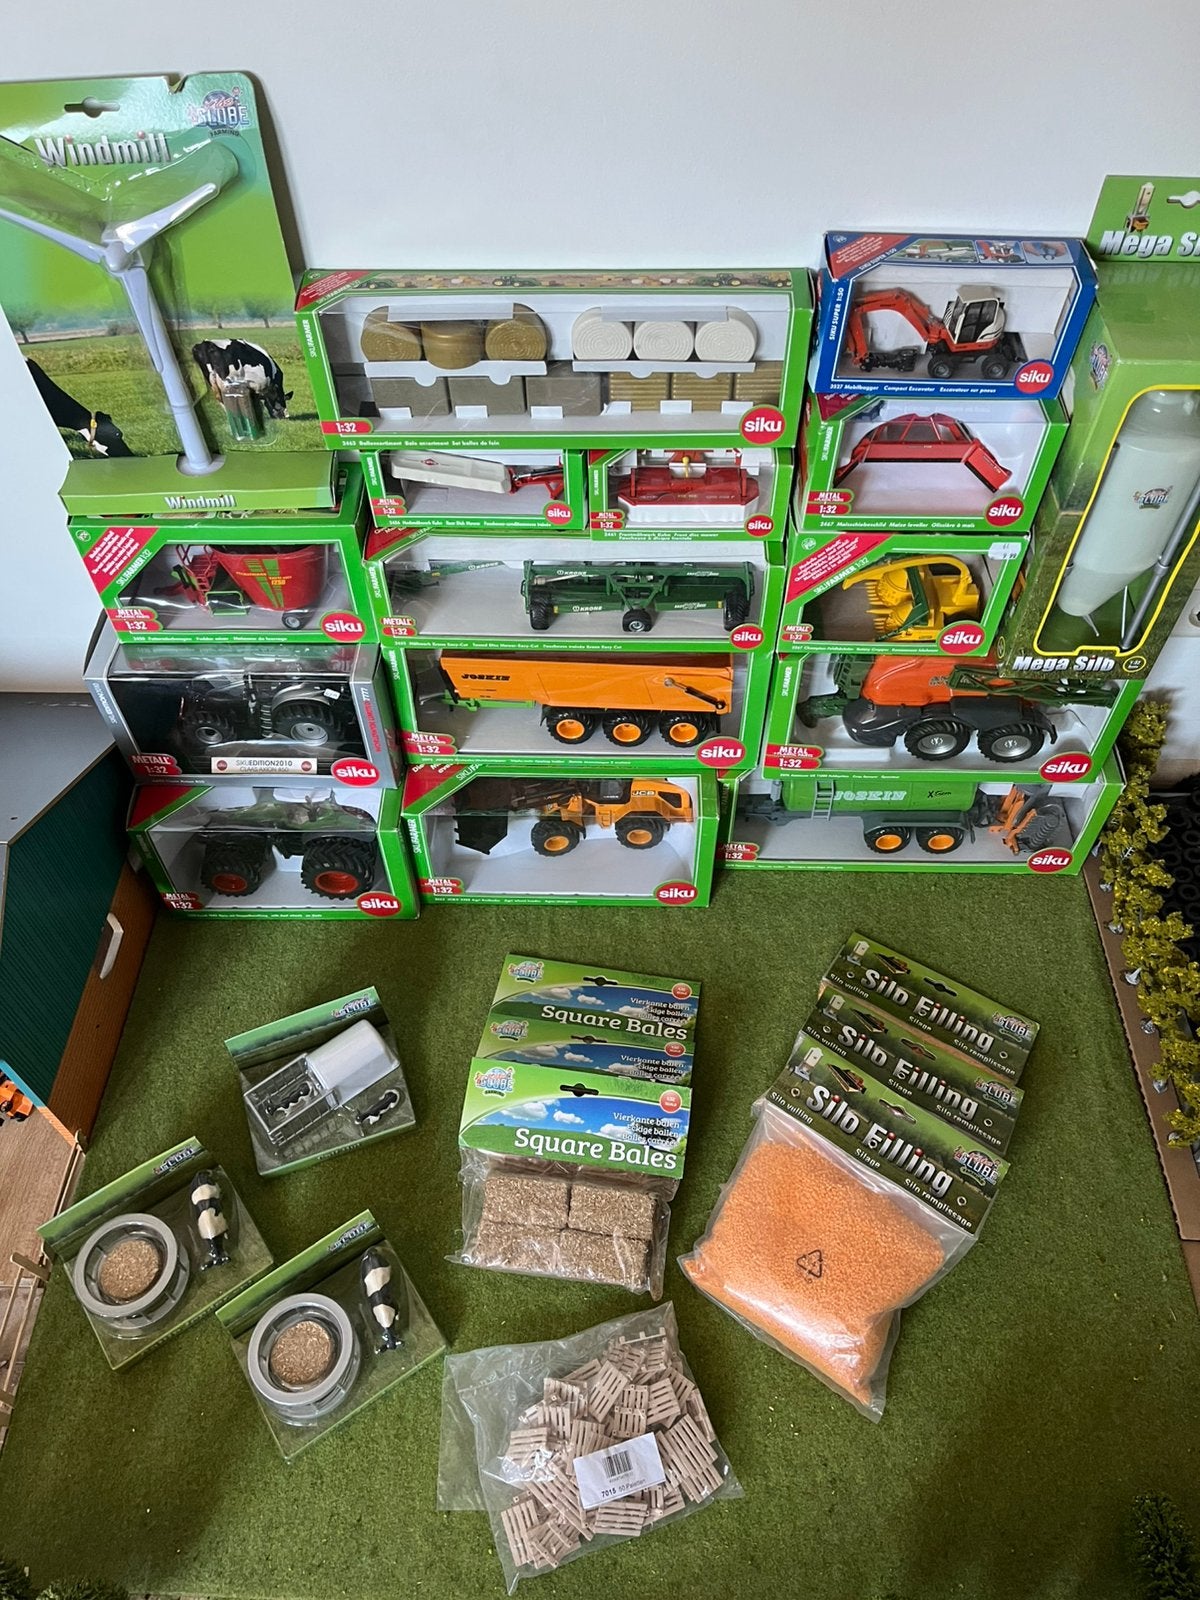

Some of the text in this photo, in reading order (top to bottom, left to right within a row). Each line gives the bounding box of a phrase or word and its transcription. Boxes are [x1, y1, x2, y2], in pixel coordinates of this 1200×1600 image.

[35, 130, 171, 167] Windmill
[1101, 231, 1173, 258] Mega
[829, 287, 845, 340] SIKU SUPER 1:50
[1018, 370, 1051, 384] siku
[335, 422, 357, 433] 1:32
[744, 417, 782, 433] siku
[164, 494, 237, 509] Windmill
[818, 492, 841, 500] METAL
[547, 508, 570, 518] siku
[819, 505, 838, 514] 1:32
[988, 506, 1022, 518] siku
[600, 521, 614, 529] 1:32
[747, 521, 772, 530] siku
[813, 565, 857, 595] SIKUFARMER
[854, 557, 869, 568] 1:32
[125, 621, 148, 630] 1:32
[325, 619, 363, 633] siku
[382, 617, 413, 626] METALL
[390, 628, 408, 636] 1:32
[733, 632, 762, 642] siku
[943, 632, 981, 645] siku
[1012, 656, 1070, 672] Mega
[411, 733, 440, 742] METAL
[418, 744, 440, 754] 1:32
[701, 746, 743, 758] siku
[779, 746, 808, 754] METAL
[131, 755, 171, 765] METALL
[235, 759, 293, 767] SIKUEDITION2010
[779, 759, 802, 768] 1:32
[145, 766, 168, 774] 1:32
[336, 767, 377, 780] siku
[1044, 761, 1089, 774] siku
[833, 790, 907, 801] JOSKIN
[1031, 855, 1070, 866] siku
[432, 886, 453, 894] 1:32
[658, 889, 695, 899] siku
[170, 901, 193, 910] 1:32
[360, 898, 399, 909] siku
[861, 968, 910, 1007] Silo
[630, 997, 690, 1011] Vierkante balen
[541, 1005, 688, 1041] Square Bales
[908, 1015, 932, 1032] Silage
[837, 1025, 888, 1068] Silo
[621, 1054, 684, 1068] Vierkante balen
[888, 1078, 913, 1097] Silage
[769, 1091, 814, 1125] Silo vulling
[806, 1085, 860, 1135] Silo
[613, 1112, 680, 1128] Vierkante balen
[936, 1104, 1002, 1146] Silo remplissage
[653, 1127, 680, 1138] ballen
[514, 1128, 677, 1171] Square Bales
[855, 1147, 881, 1169] Silage
[904, 1178, 973, 1229] Silo remplissage
[601, 1487, 617, 1498] 7015
